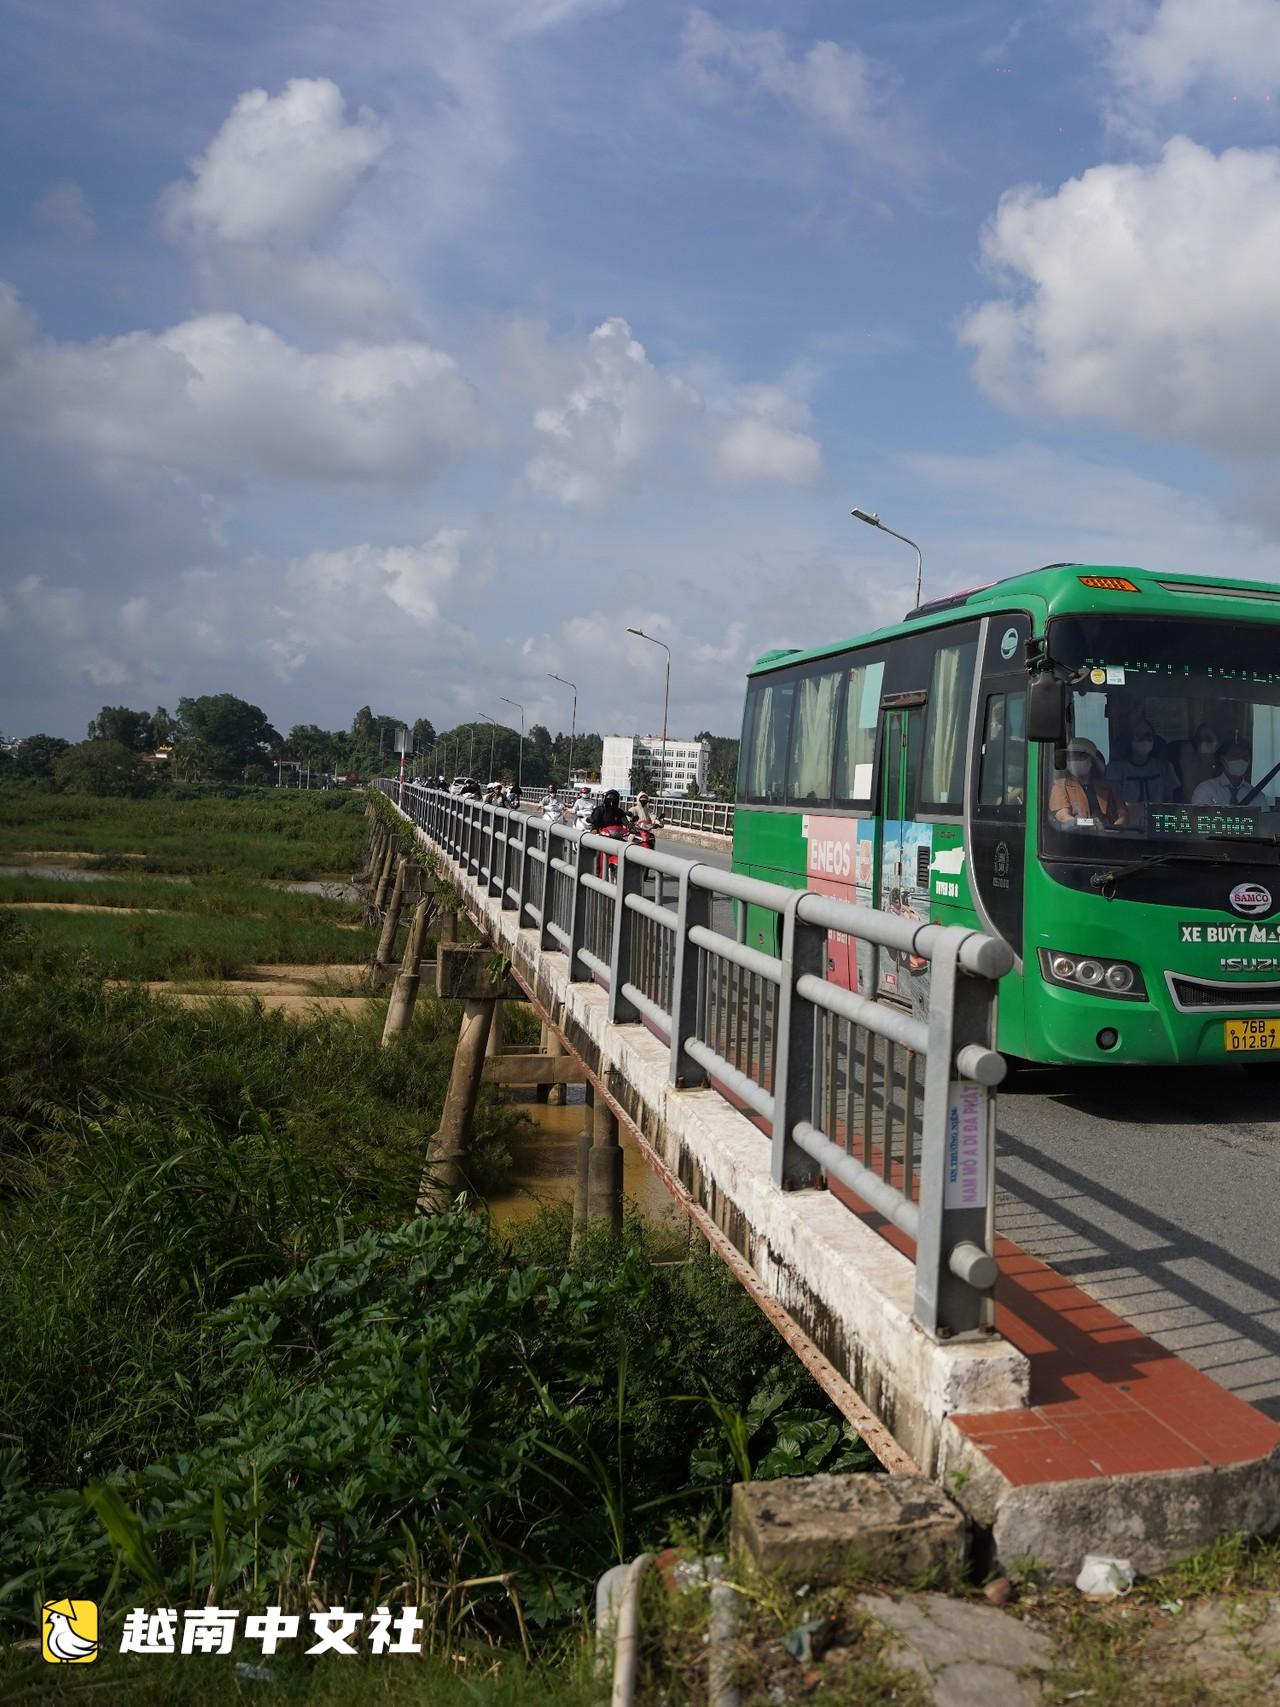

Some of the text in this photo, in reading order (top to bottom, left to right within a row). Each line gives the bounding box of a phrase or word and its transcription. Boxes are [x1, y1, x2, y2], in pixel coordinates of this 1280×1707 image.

[810, 839, 851, 877] ENEOS
[1234, 894, 1269, 903] SAMCO
[1181, 926, 1202, 943] XE
[1207, 923, 1248, 943] BUÝT
[1242, 1020, 1266, 1034] 76B
[1232, 1034, 1276, 1049] 012.87
[962, 1179, 977, 1202] NAM
